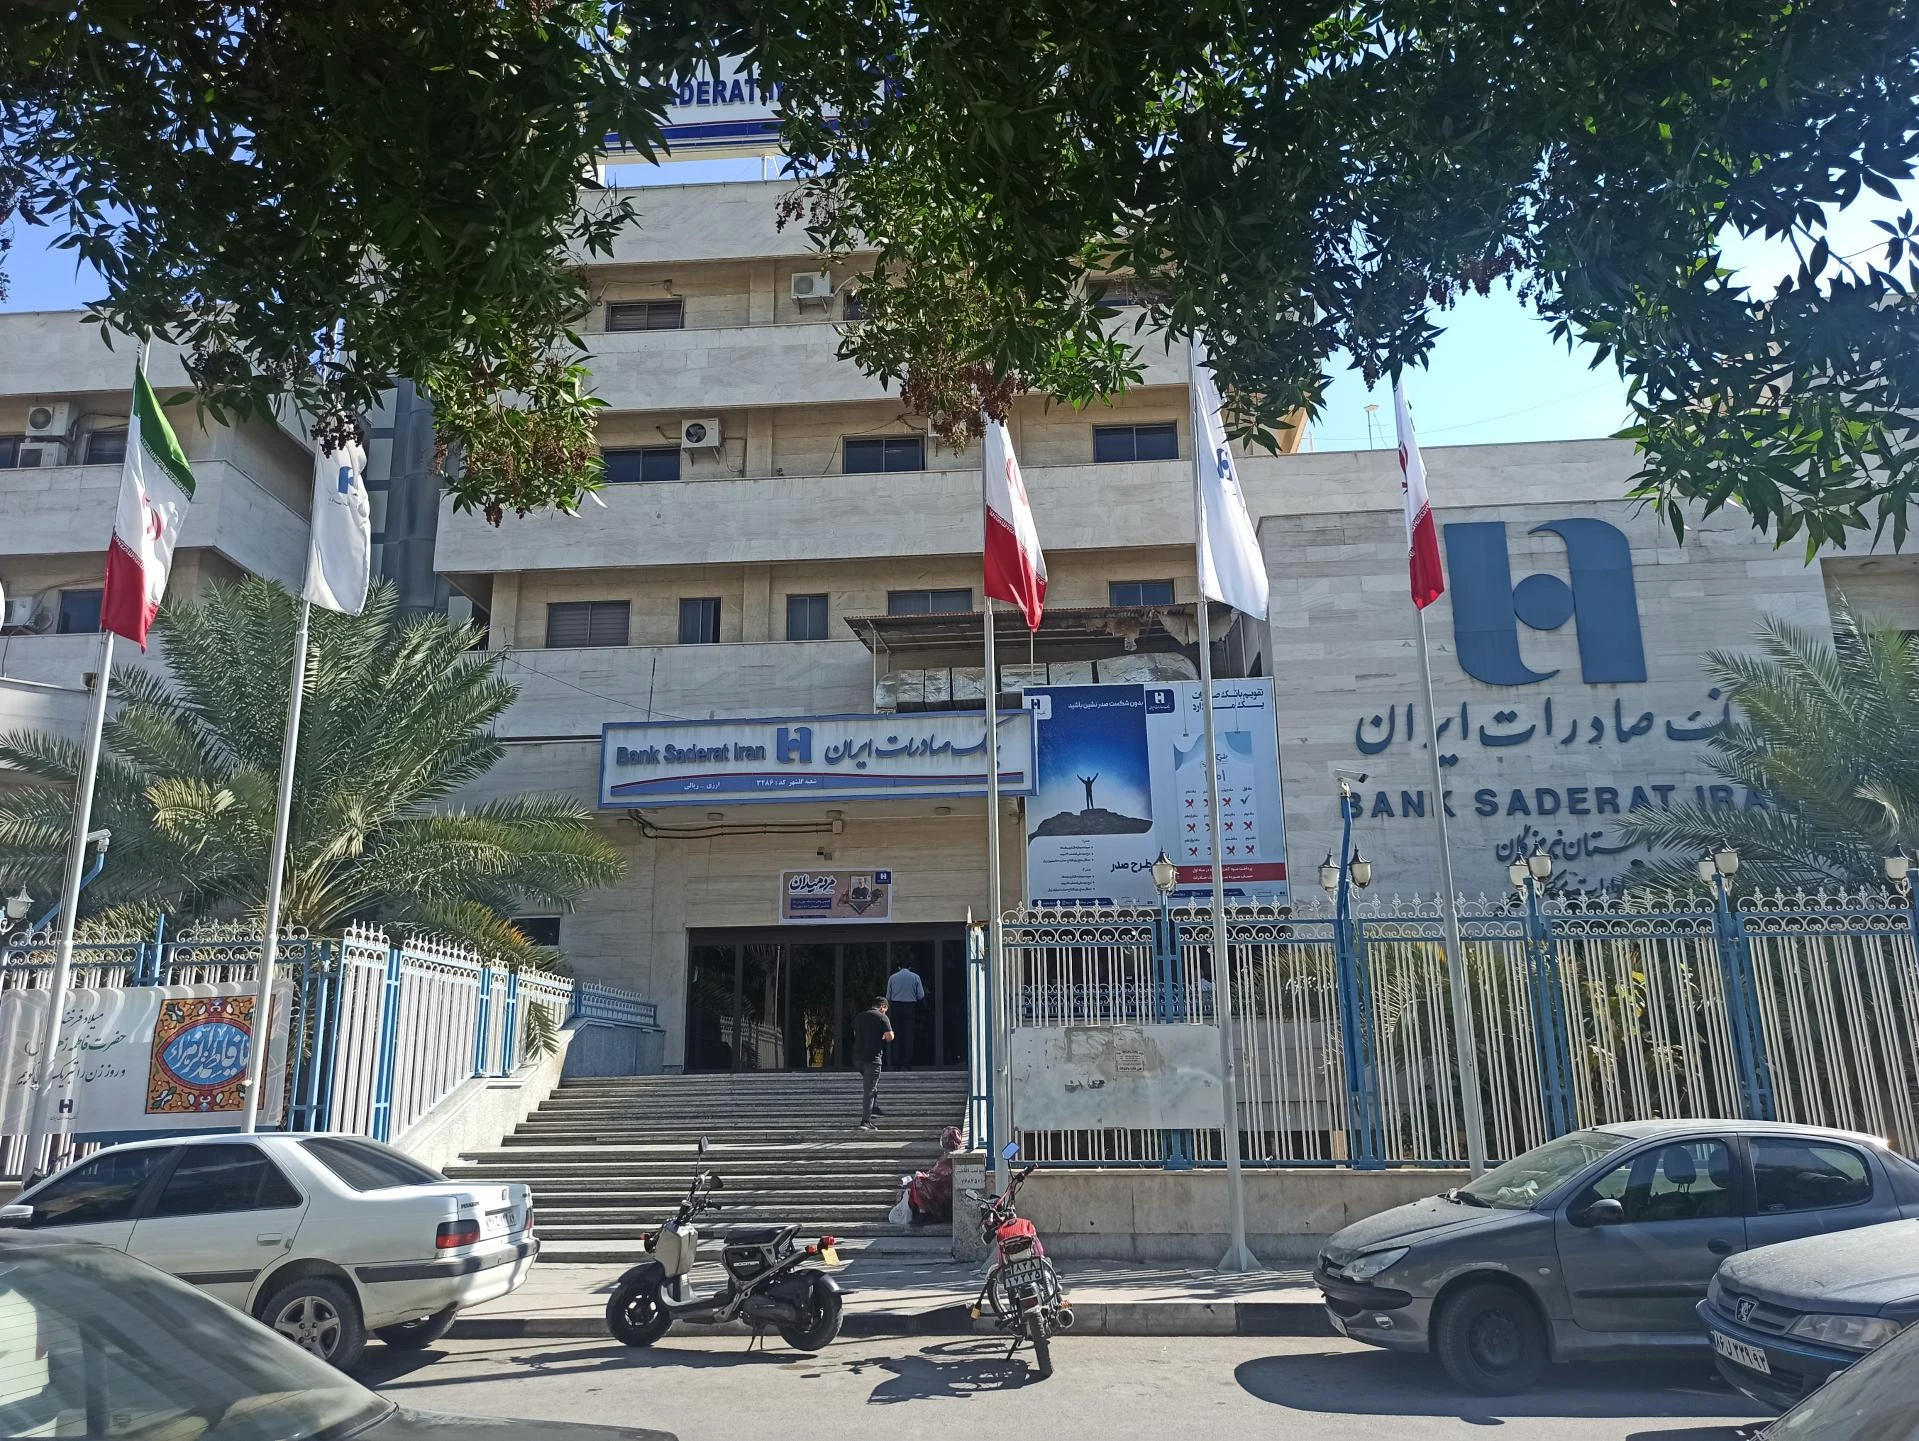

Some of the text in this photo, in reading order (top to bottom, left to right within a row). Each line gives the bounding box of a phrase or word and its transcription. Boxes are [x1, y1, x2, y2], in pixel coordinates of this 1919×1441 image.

[1479, 697, 1654, 747] صادرات
[616, 742, 766, 765] Bank Saderat Iran
[825, 738, 872, 769] ایران
[875, 733, 951, 758] صادرات
[1340, 784, 1772, 819] BANK SADERAT IRA
[1111, 860, 1129, 872] صدر
